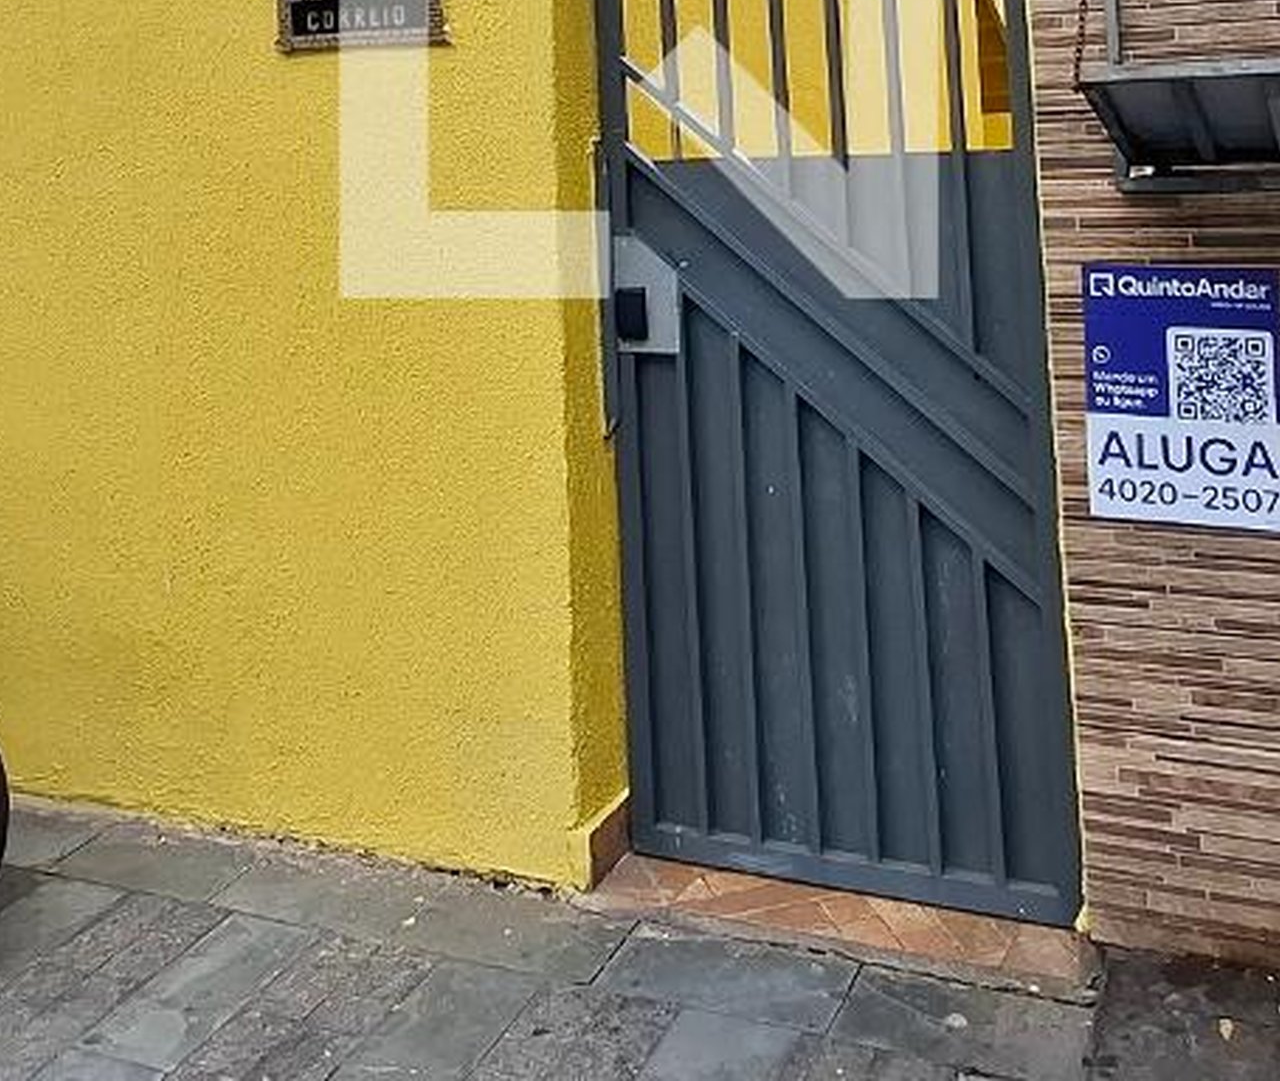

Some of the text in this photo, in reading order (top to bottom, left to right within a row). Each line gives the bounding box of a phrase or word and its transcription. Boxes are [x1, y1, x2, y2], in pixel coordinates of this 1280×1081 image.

[1118, 274, 1270, 300] QuintoAndar
[1097, 430, 1280, 480] ALUGA
[1098, 477, 1280, 514] 4020-2507
